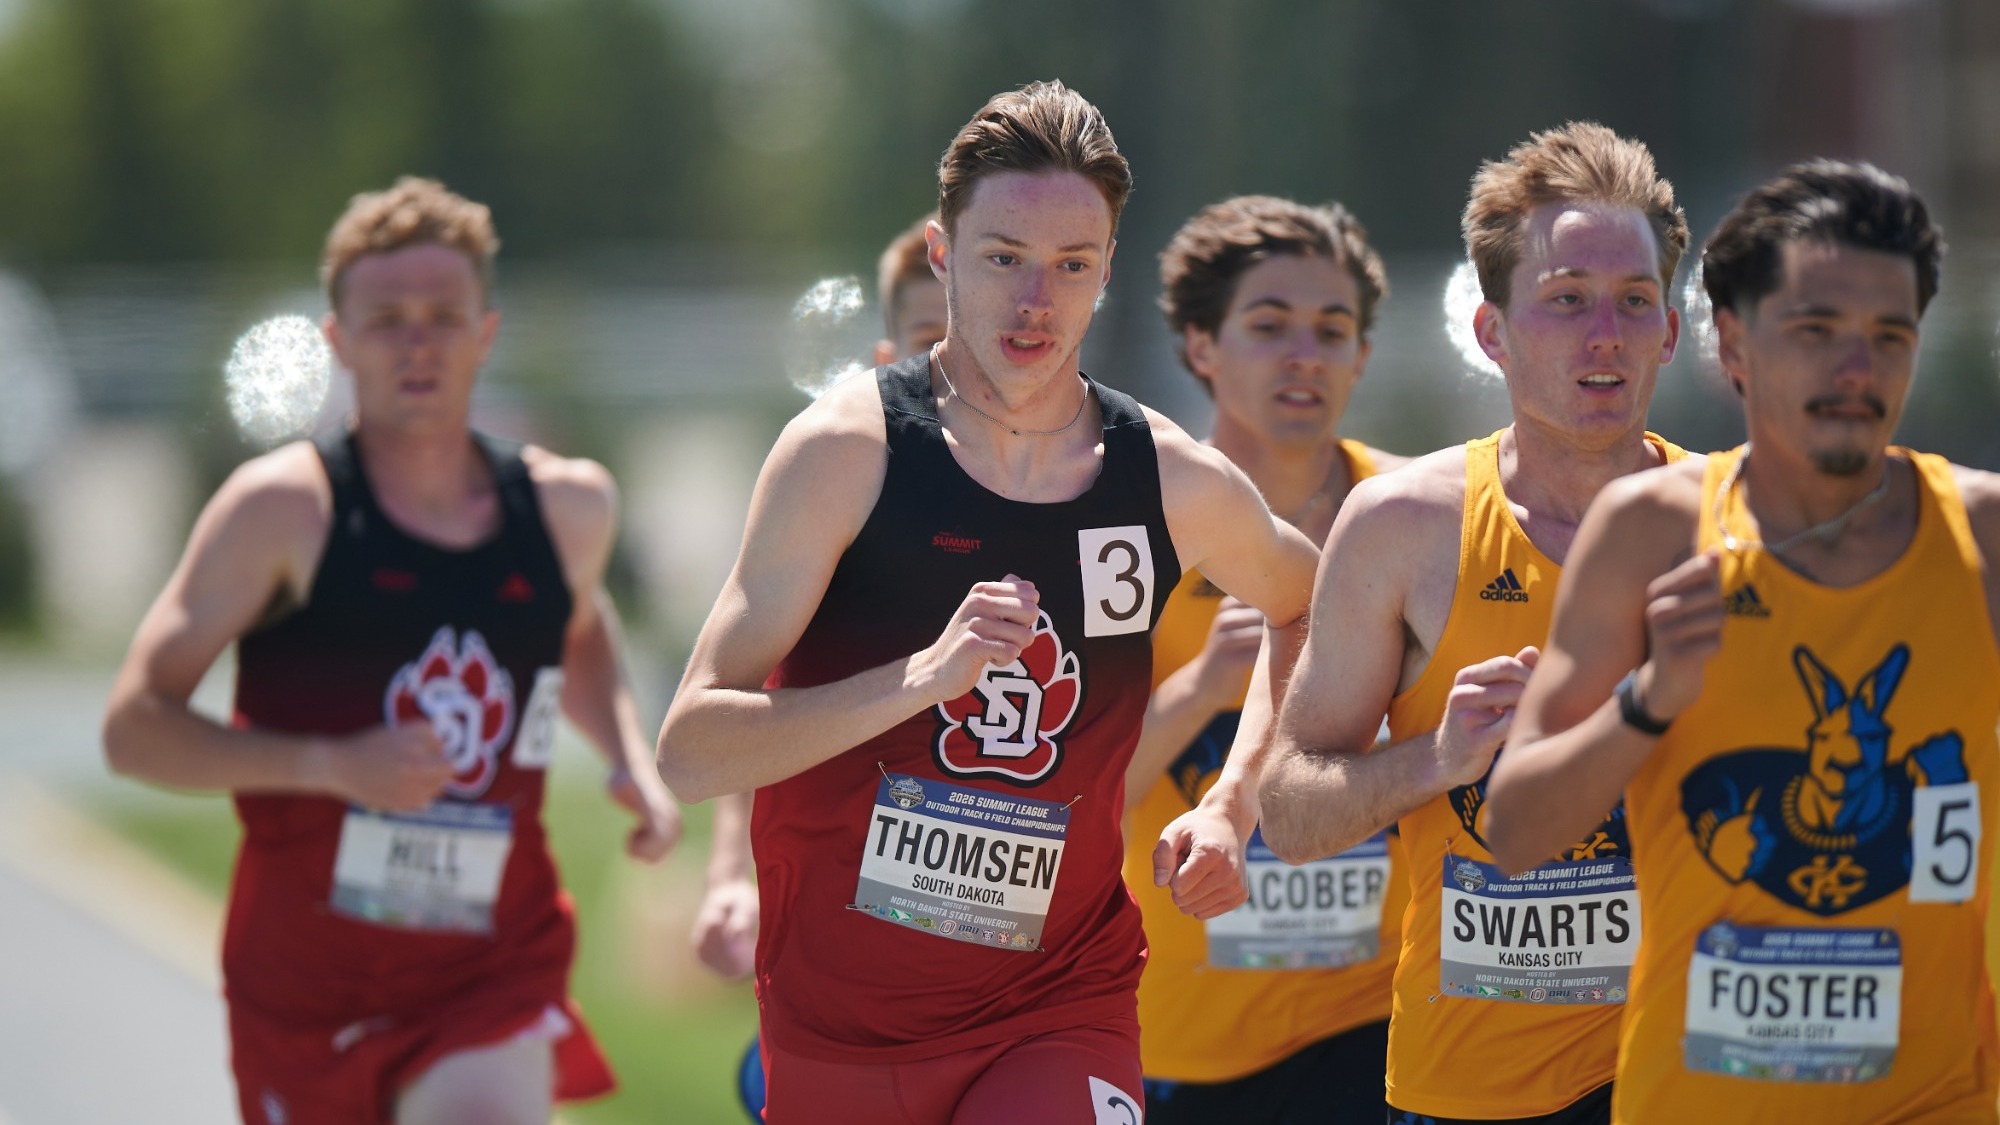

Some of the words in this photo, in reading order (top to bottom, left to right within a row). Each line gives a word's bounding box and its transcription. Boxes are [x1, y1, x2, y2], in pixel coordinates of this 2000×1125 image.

[932, 536, 982, 549] SUMMIT
[1097, 539, 1145, 621] 3
[1480, 588, 1529, 603] adidas
[925, 800, 960, 815] OUTDOOR
[961, 808, 985, 820] TRACK
[991, 814, 1011, 825] FIELD
[1011, 818, 1066, 833] CHAMPIONSHIPS
[949, 791, 975, 806] 2026
[976, 797, 1016, 812] SUMMIT
[1016, 804, 1049, 818] LEAGUE
[875, 814, 1058, 890] THOMSEN
[1931, 799, 1974, 886] 5
[1488, 883, 1522, 892] OUTDOOR
[1524, 883, 1548, 892] TRACK
[1549, 882, 1555, 890] &
[1556, 881, 1576, 890] FIELD
[1577, 874, 1638, 888] CHAMPIONSHIPS
[1538, 867, 1578, 880] SUMMIT
[1579, 863, 1615, 876] LEAGUE
[912, 874, 953, 897] SOUTH
[956, 884, 1005, 907] DAKOTA
[942, 901, 963, 910] HOSTED
[1247, 867, 1384, 914] COBER
[890, 896, 917, 909] NORTH
[917, 902, 948, 917] DAKOTA
[949, 911, 973, 922] STATE
[974, 915, 1018, 930] UNIVERSITY
[1453, 898, 1630, 948] SWARTS
[1498, 951, 1550, 967] KANSAS
[1554, 951, 1583, 966] CITY
[1475, 974, 1502, 983] NORTH
[1504, 977, 1535, 987] DAKOTA
[1536, 979, 1560, 988] STATE
[1562, 976, 1609, 987] UNIVERSITY
[1710, 968, 1879, 1020] FOSTER
